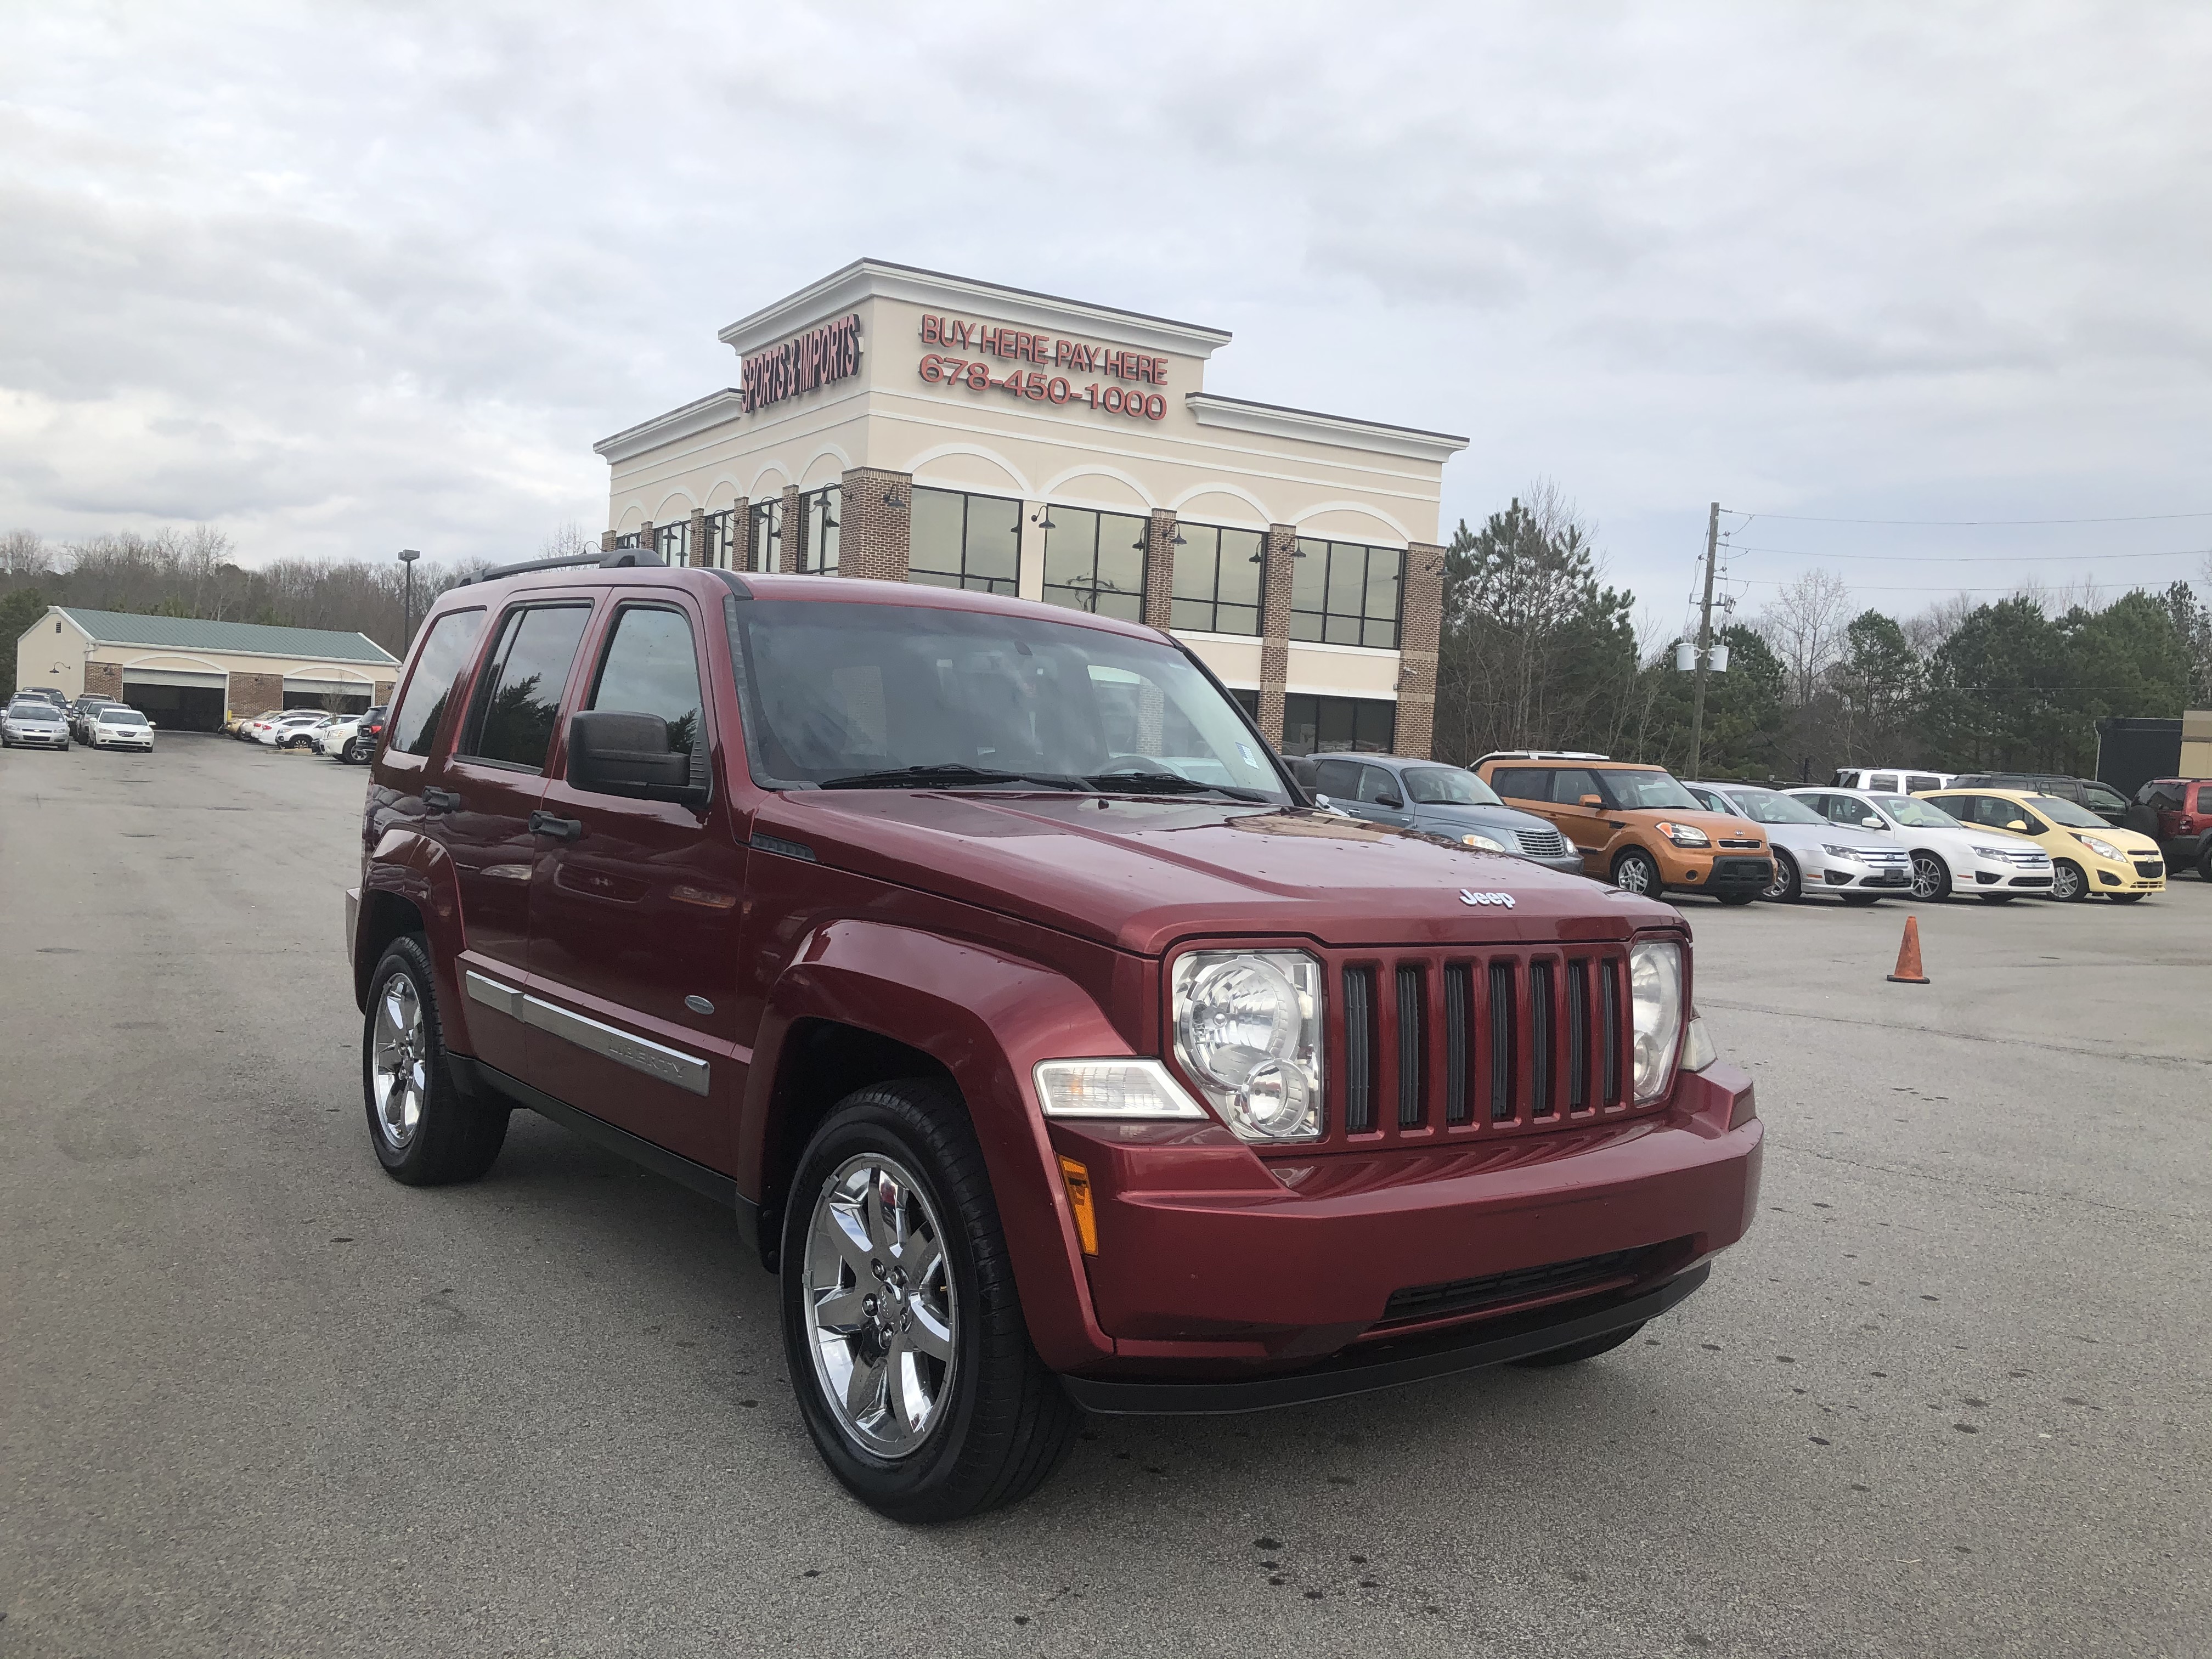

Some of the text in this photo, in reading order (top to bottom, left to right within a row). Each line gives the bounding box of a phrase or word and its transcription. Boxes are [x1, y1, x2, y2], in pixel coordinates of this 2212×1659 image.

[741, 313, 860, 414] SPORTS & IMPORTS
[922, 314, 1168, 385] BUY HERE PAY HERE
[919, 354, 1167, 420] 678-450-1000
[1459, 889, 1516, 910] Jeep
[609, 1040, 686, 1078] LIBERTY
